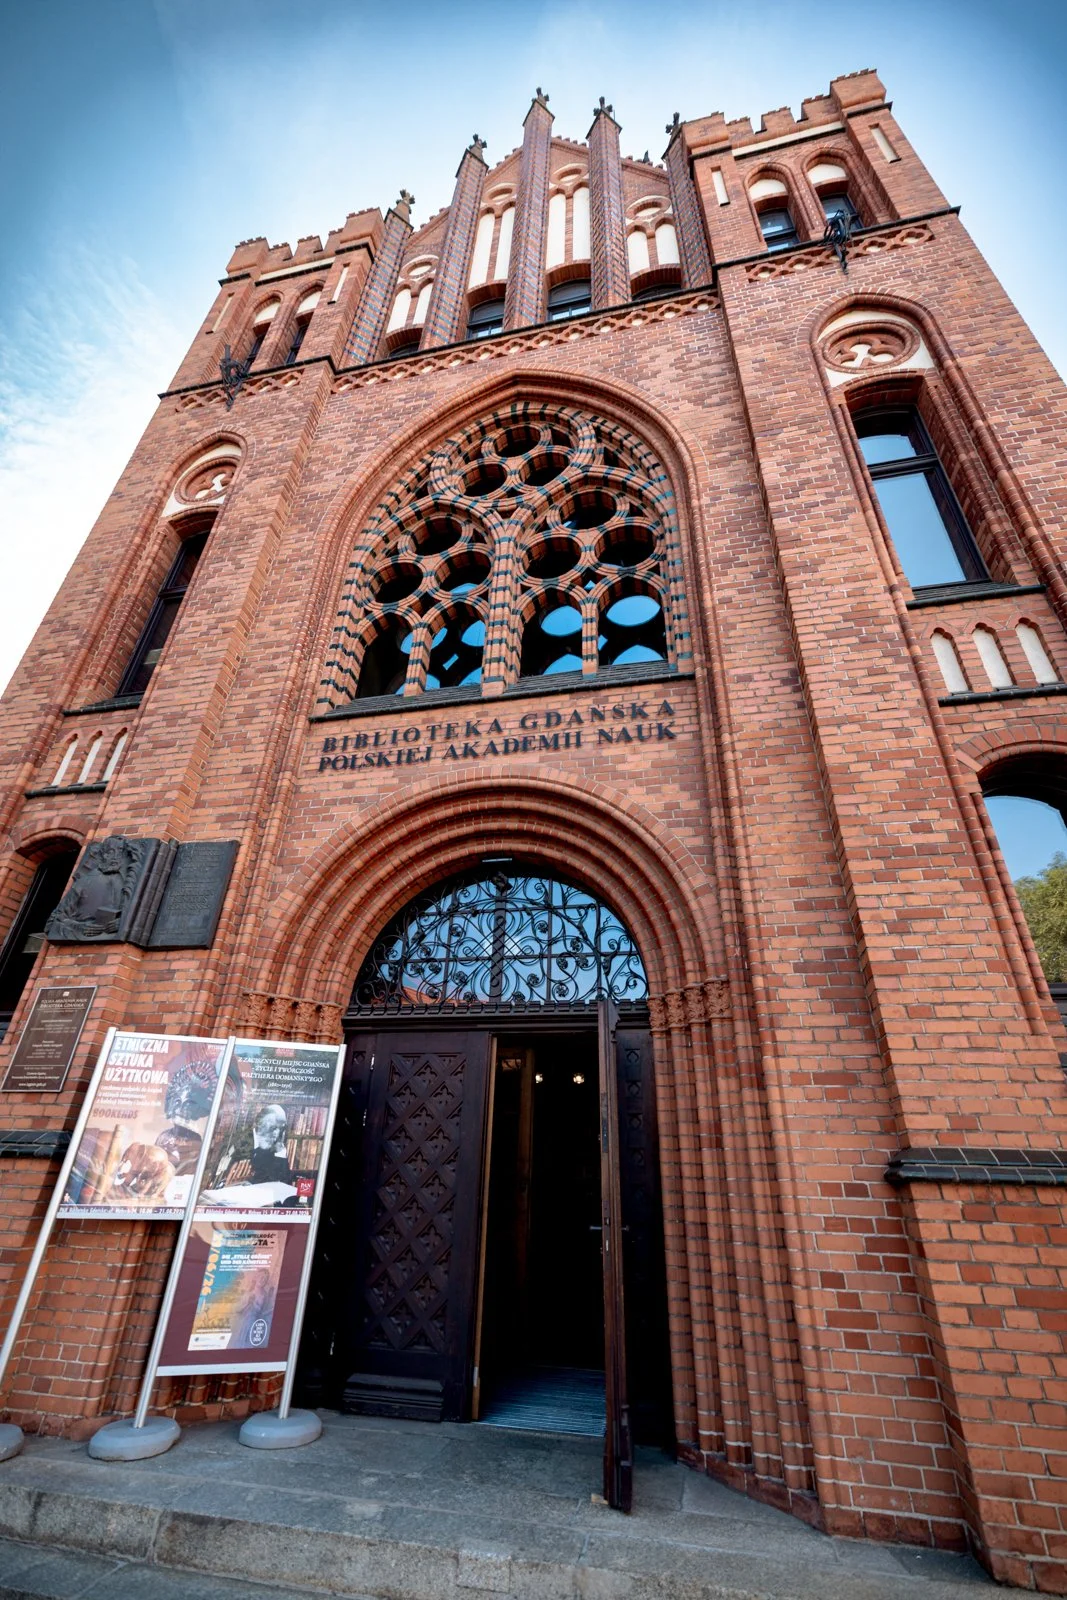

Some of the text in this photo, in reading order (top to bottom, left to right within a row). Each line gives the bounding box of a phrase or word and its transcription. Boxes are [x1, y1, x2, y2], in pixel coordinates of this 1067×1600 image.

[321, 718, 504, 753] BIBLIOTEKA
[317, 721, 678, 772] POLSKIEJ AKADEMII NAUK
[114, 1037, 170, 1054] ETNICZNA
[107, 1052, 154, 1068] SZTUKA
[104, 1067, 170, 1085] UŻYTKOWA
[92, 1107, 139, 1120] BOOKENDS
